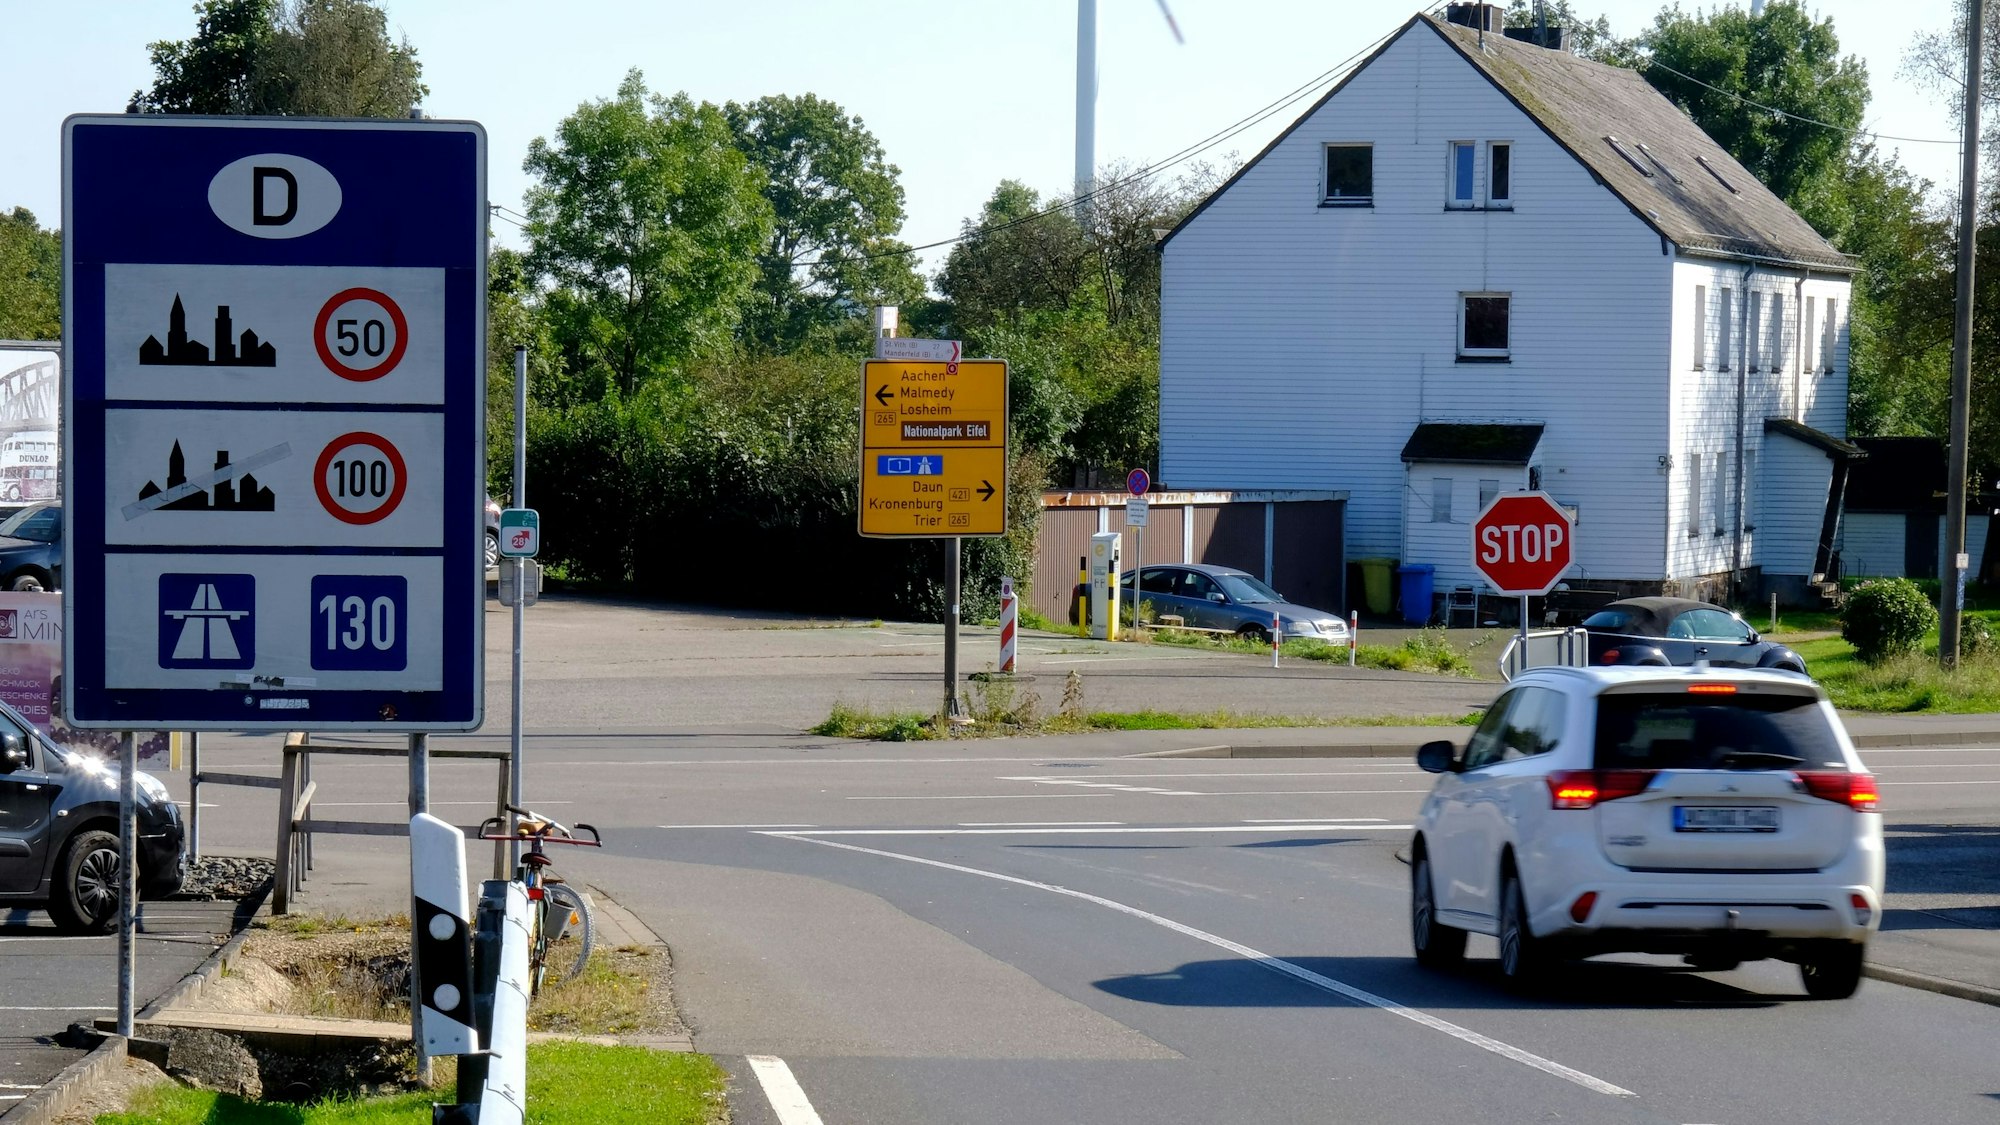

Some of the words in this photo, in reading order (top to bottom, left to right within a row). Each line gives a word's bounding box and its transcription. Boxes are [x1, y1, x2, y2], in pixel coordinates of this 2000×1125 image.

[253, 166, 298, 226] D
[337, 319, 385, 357] 50
[884, 349, 920, 357] Manderfeld
[901, 370, 946, 381] Aachen
[900, 387, 955, 400] Malmedy
[900, 403, 952, 415] Losheim
[877, 415, 894, 423] 265
[904, 425, 962, 440] Nationalpark
[966, 424, 987, 437] Eifel
[19, 454, 49, 463] DUNLOP
[333, 460, 387, 498] 100
[913, 481, 943, 493] Daun
[952, 490, 967, 499] 421
[869, 498, 943, 512] Kronenburg
[913, 514, 942, 526] Trier
[951, 516, 967, 524] 265
[513, 537, 525, 546] 28
[1481, 523, 1564, 564] STOP
[319, 594, 396, 651] 130
[0, 667, 20, 675] EKO
[0, 680, 40, 688] CHMUCK
